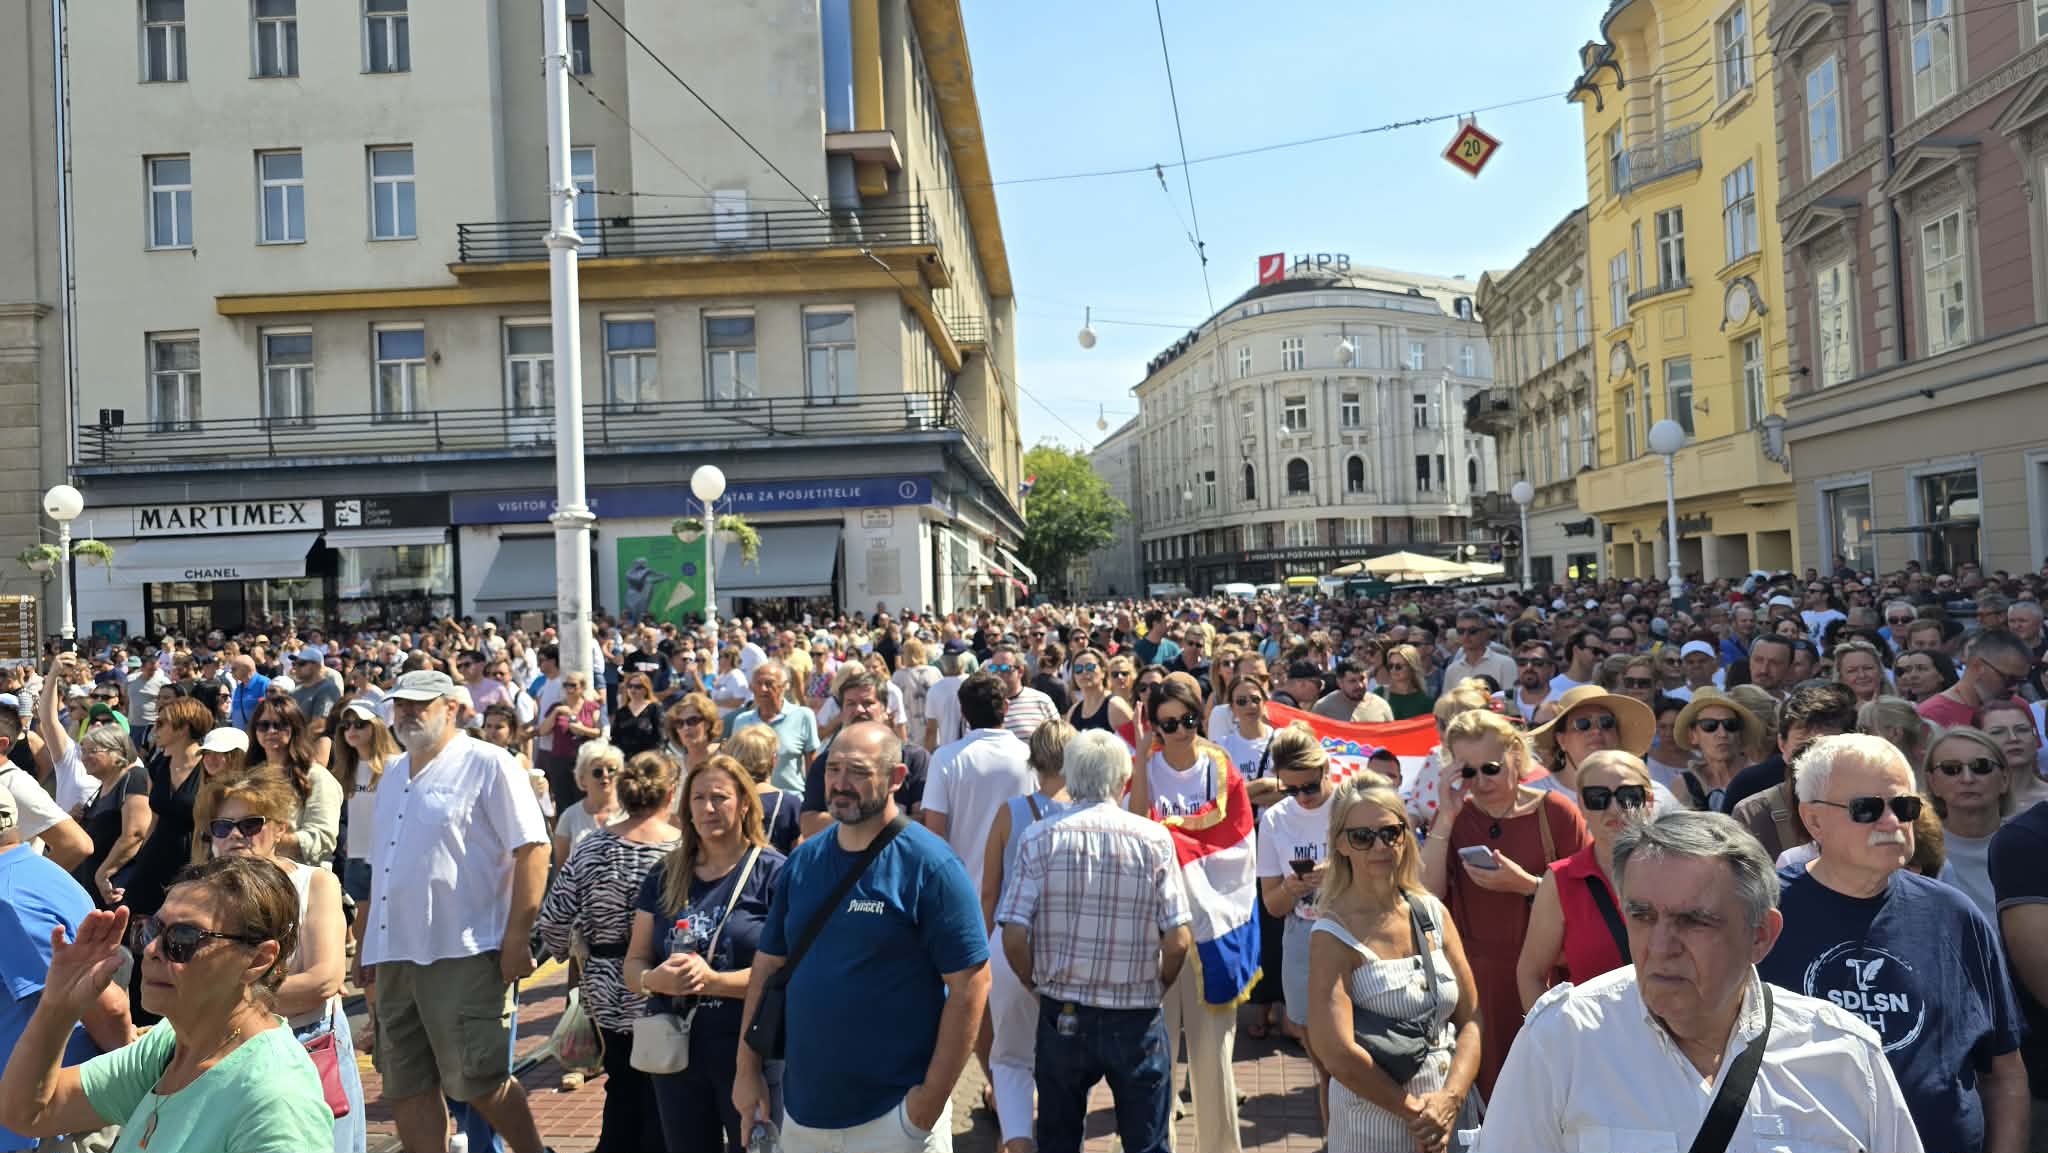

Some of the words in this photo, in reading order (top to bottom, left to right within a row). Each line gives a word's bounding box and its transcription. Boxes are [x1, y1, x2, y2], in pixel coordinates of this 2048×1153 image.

[1464, 139, 1481, 157] 20
[1294, 253, 1351, 272] HPB
[759, 491, 774, 501] ZA
[778, 487, 861, 500] POSJETITELJE
[498, 500, 547, 512] VISITOR
[139, 503, 306, 530] MARTIMEX
[184, 567, 239, 579] CHANEL
[1827, 989, 1910, 1013] SDLSN
